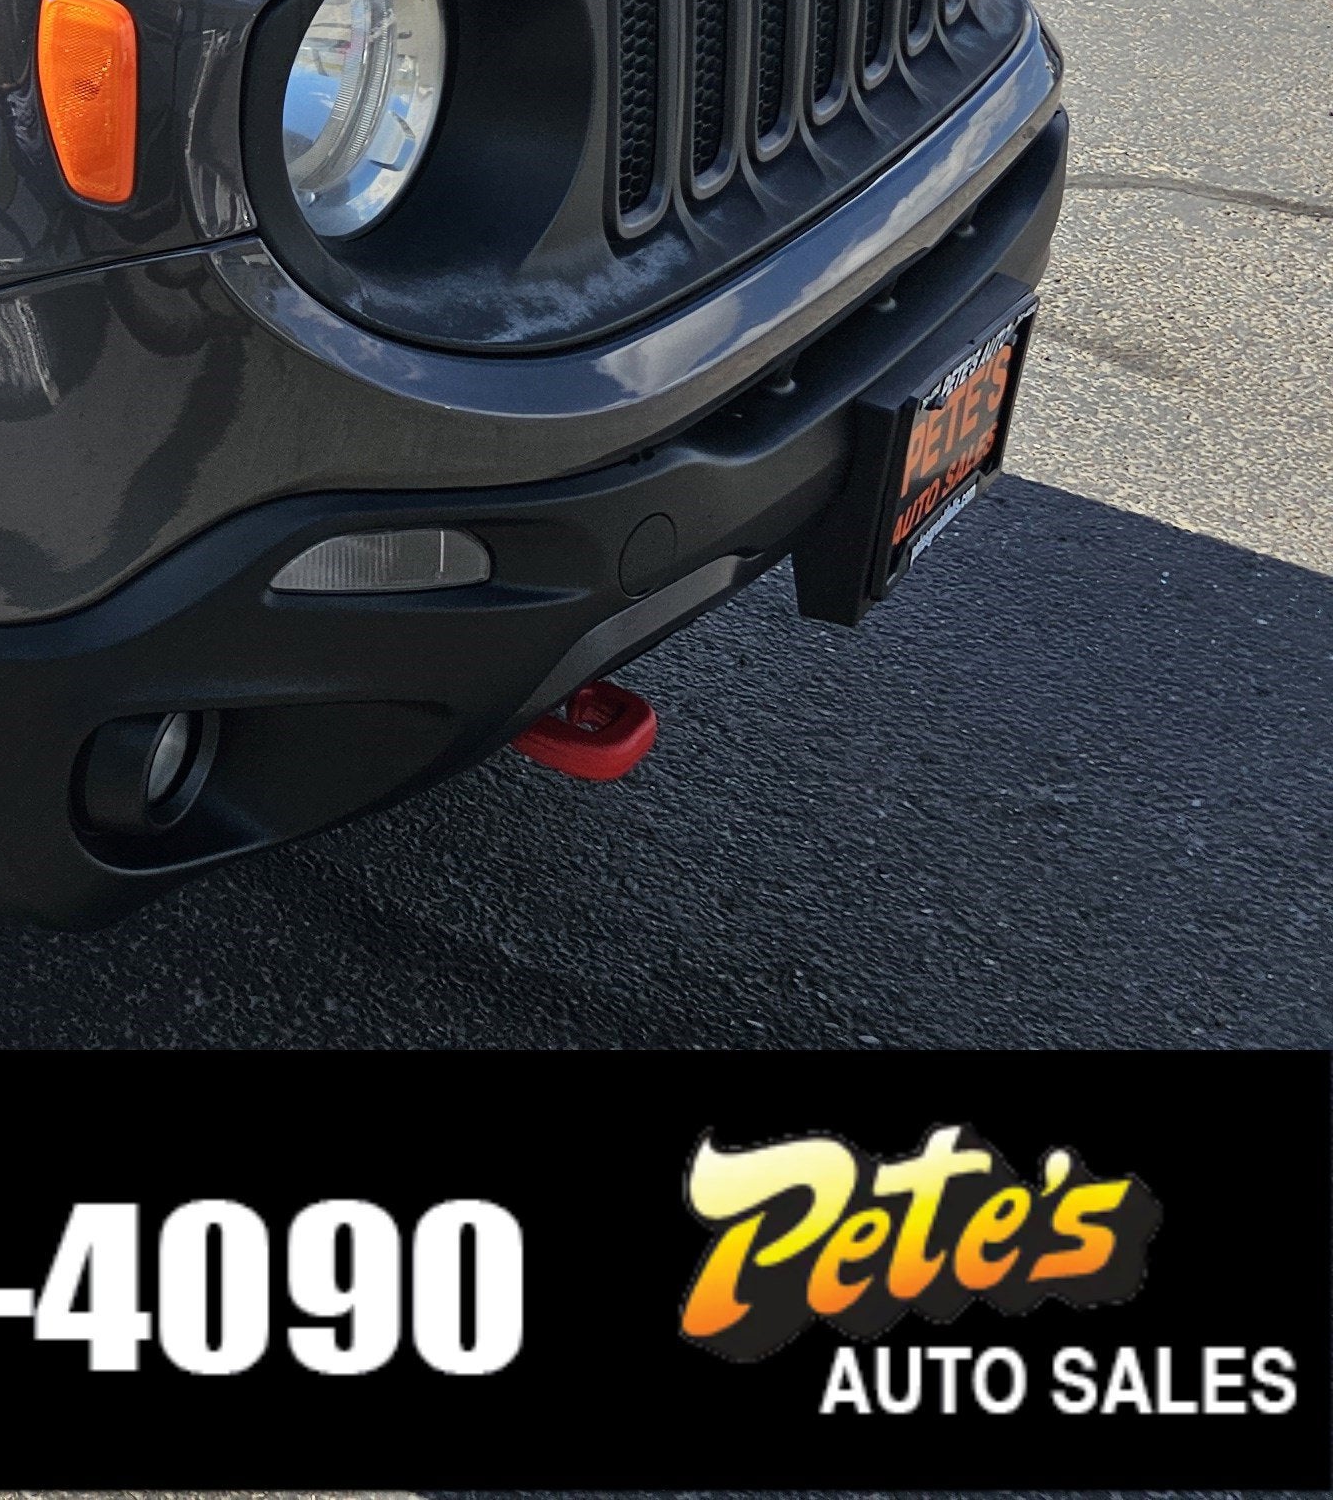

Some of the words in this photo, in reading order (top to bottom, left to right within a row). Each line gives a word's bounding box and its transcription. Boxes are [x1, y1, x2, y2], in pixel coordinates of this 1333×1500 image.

[891, 477, 941, 546] AUTO
[941, 421, 998, 498] SALES
[900, 344, 1013, 498] PETE'S
